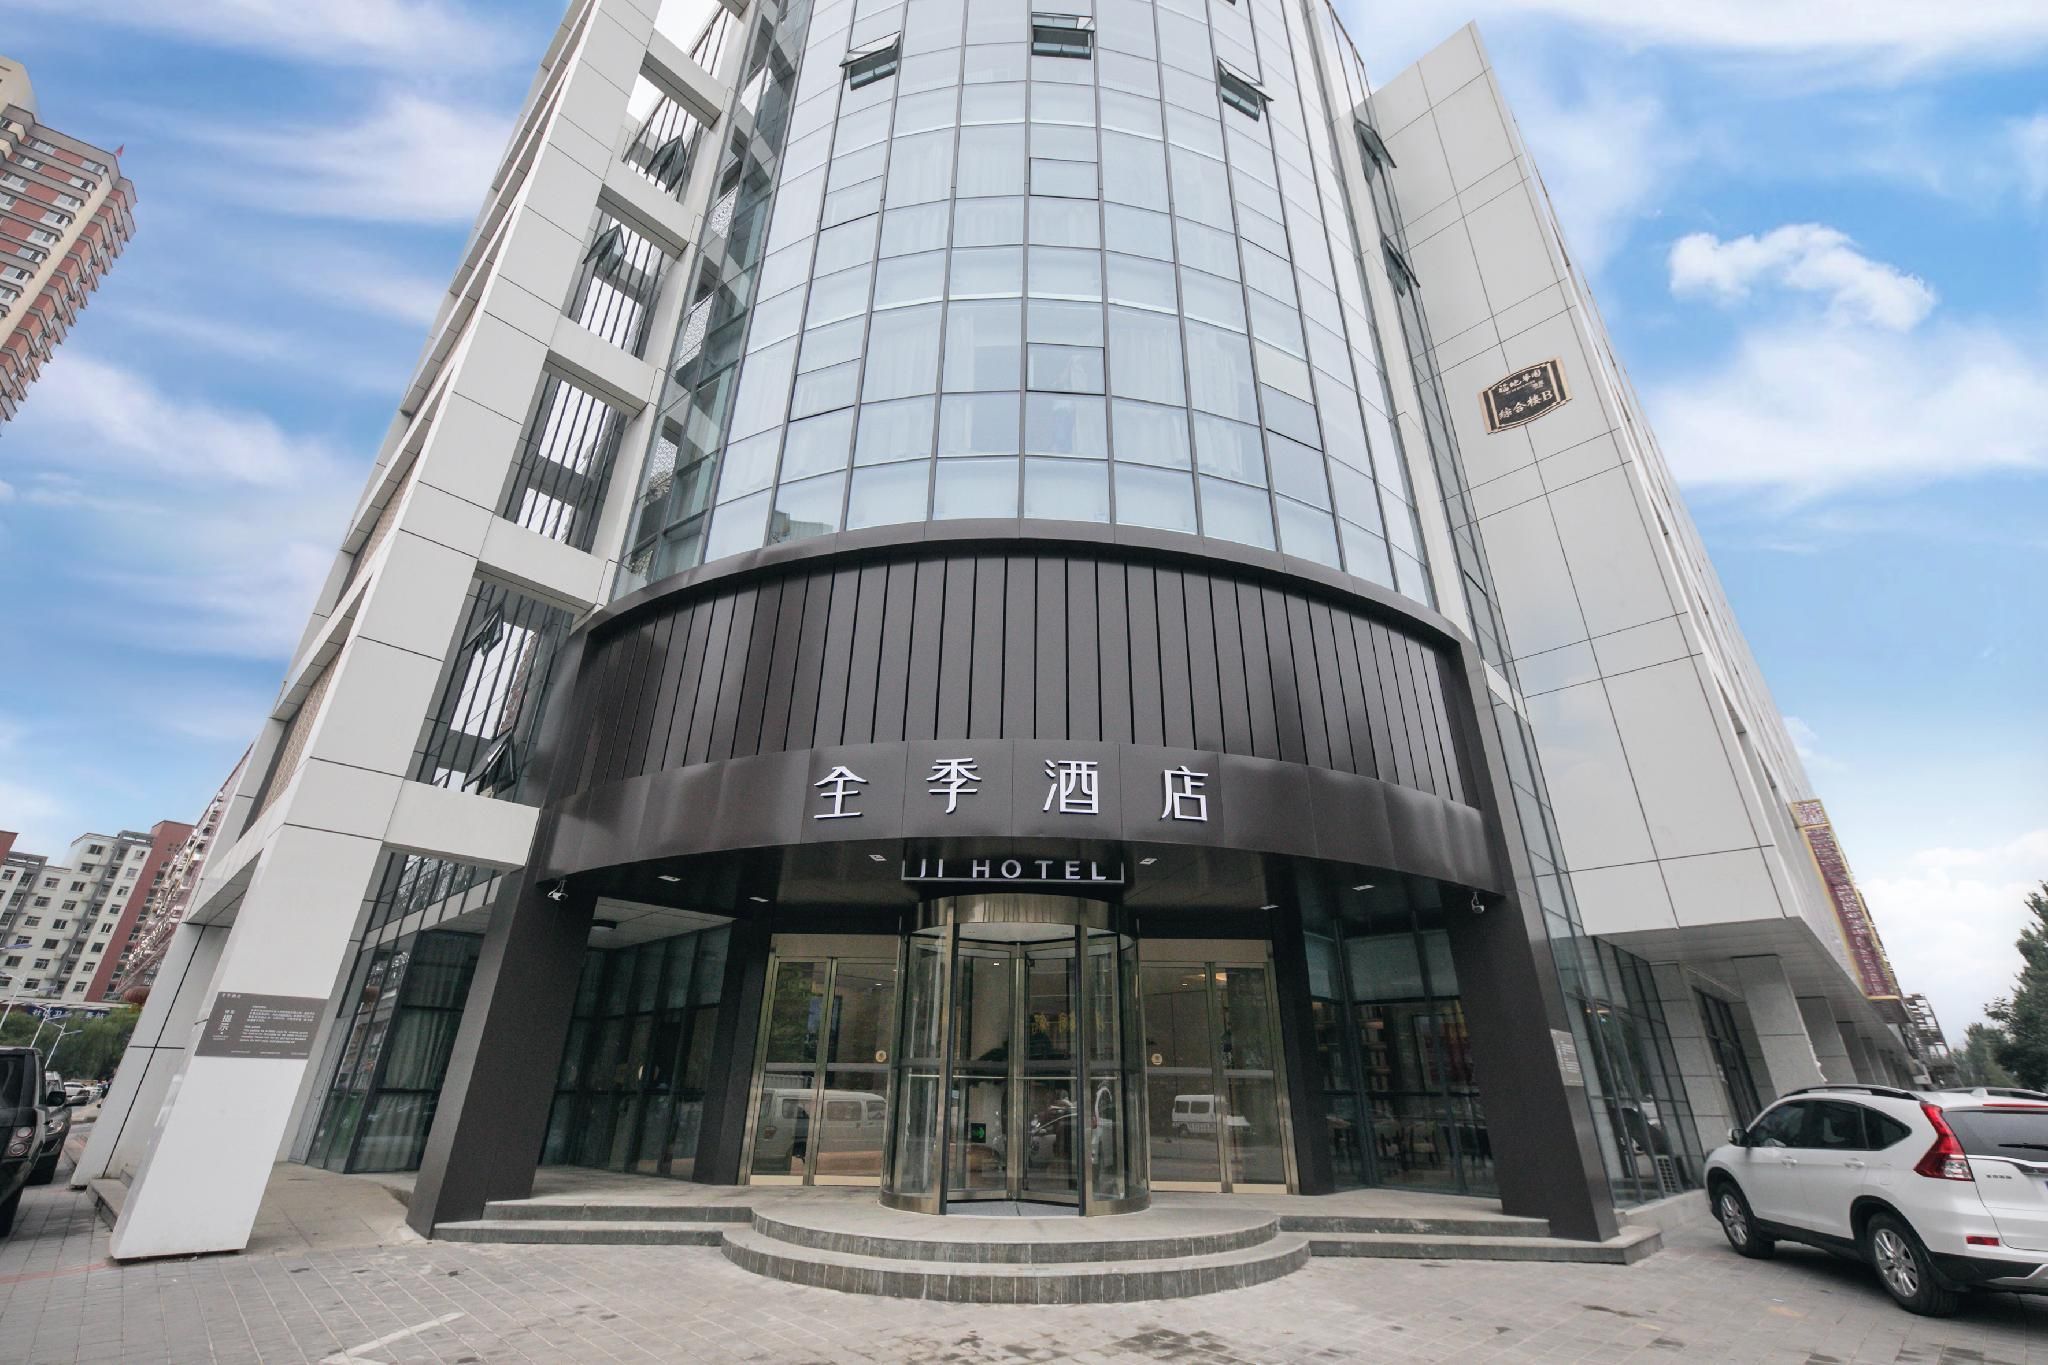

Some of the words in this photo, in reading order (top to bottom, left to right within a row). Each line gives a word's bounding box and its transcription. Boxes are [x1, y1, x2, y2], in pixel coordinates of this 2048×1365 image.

[814, 757, 1209, 822] 全季酒店
[919, 858, 944, 878] JI
[972, 858, 1107, 881] HOTEL
